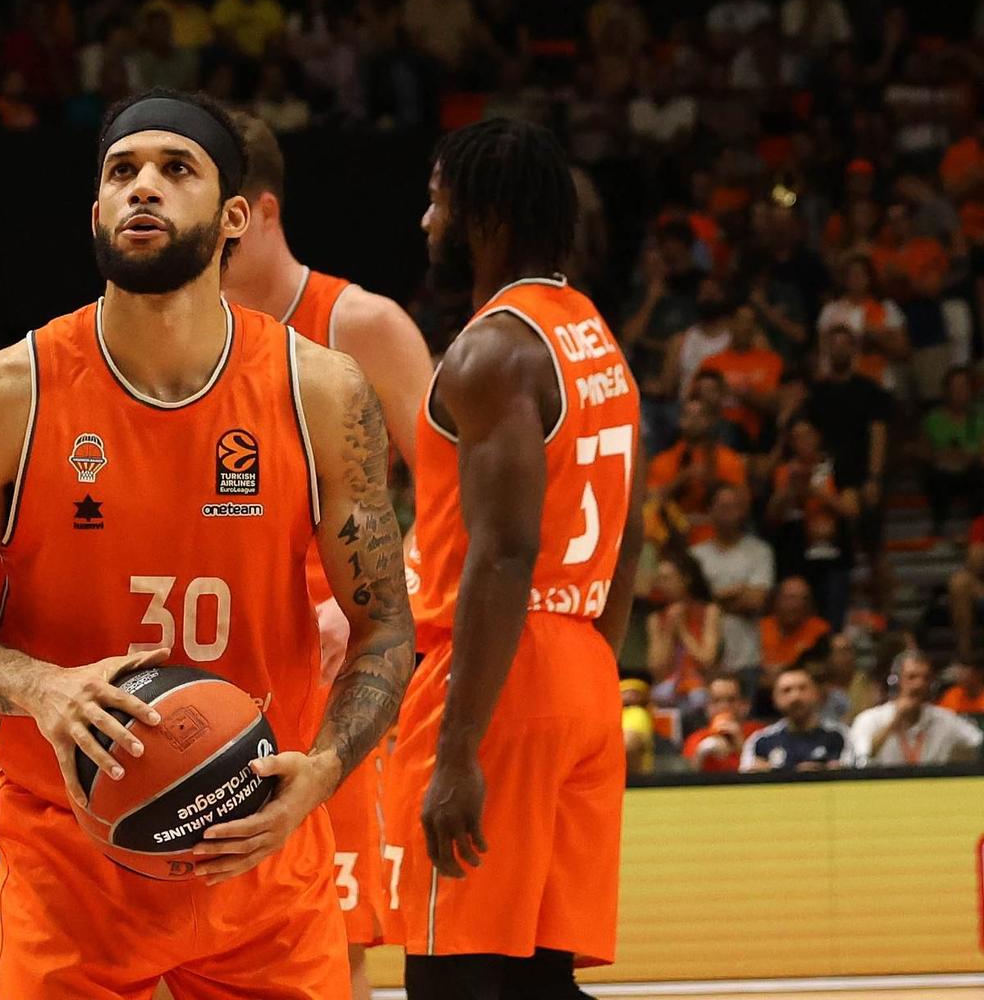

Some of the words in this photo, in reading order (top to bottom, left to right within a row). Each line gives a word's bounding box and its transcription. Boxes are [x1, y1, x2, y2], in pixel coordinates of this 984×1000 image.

[219, 486, 256, 495] EuroLeague
[220, 472, 256, 480] TURKISH
[220, 479, 256, 487] AIRLINES
[202, 502, 263, 516] oneteam
[127, 575, 232, 662] 30
[177, 762, 252, 820] uroLeague
[217, 774, 263, 817] TURKISH
[153, 811, 214, 844] AIRLINES
[333, 851, 359, 912] 3
[383, 844, 405, 910] 7
